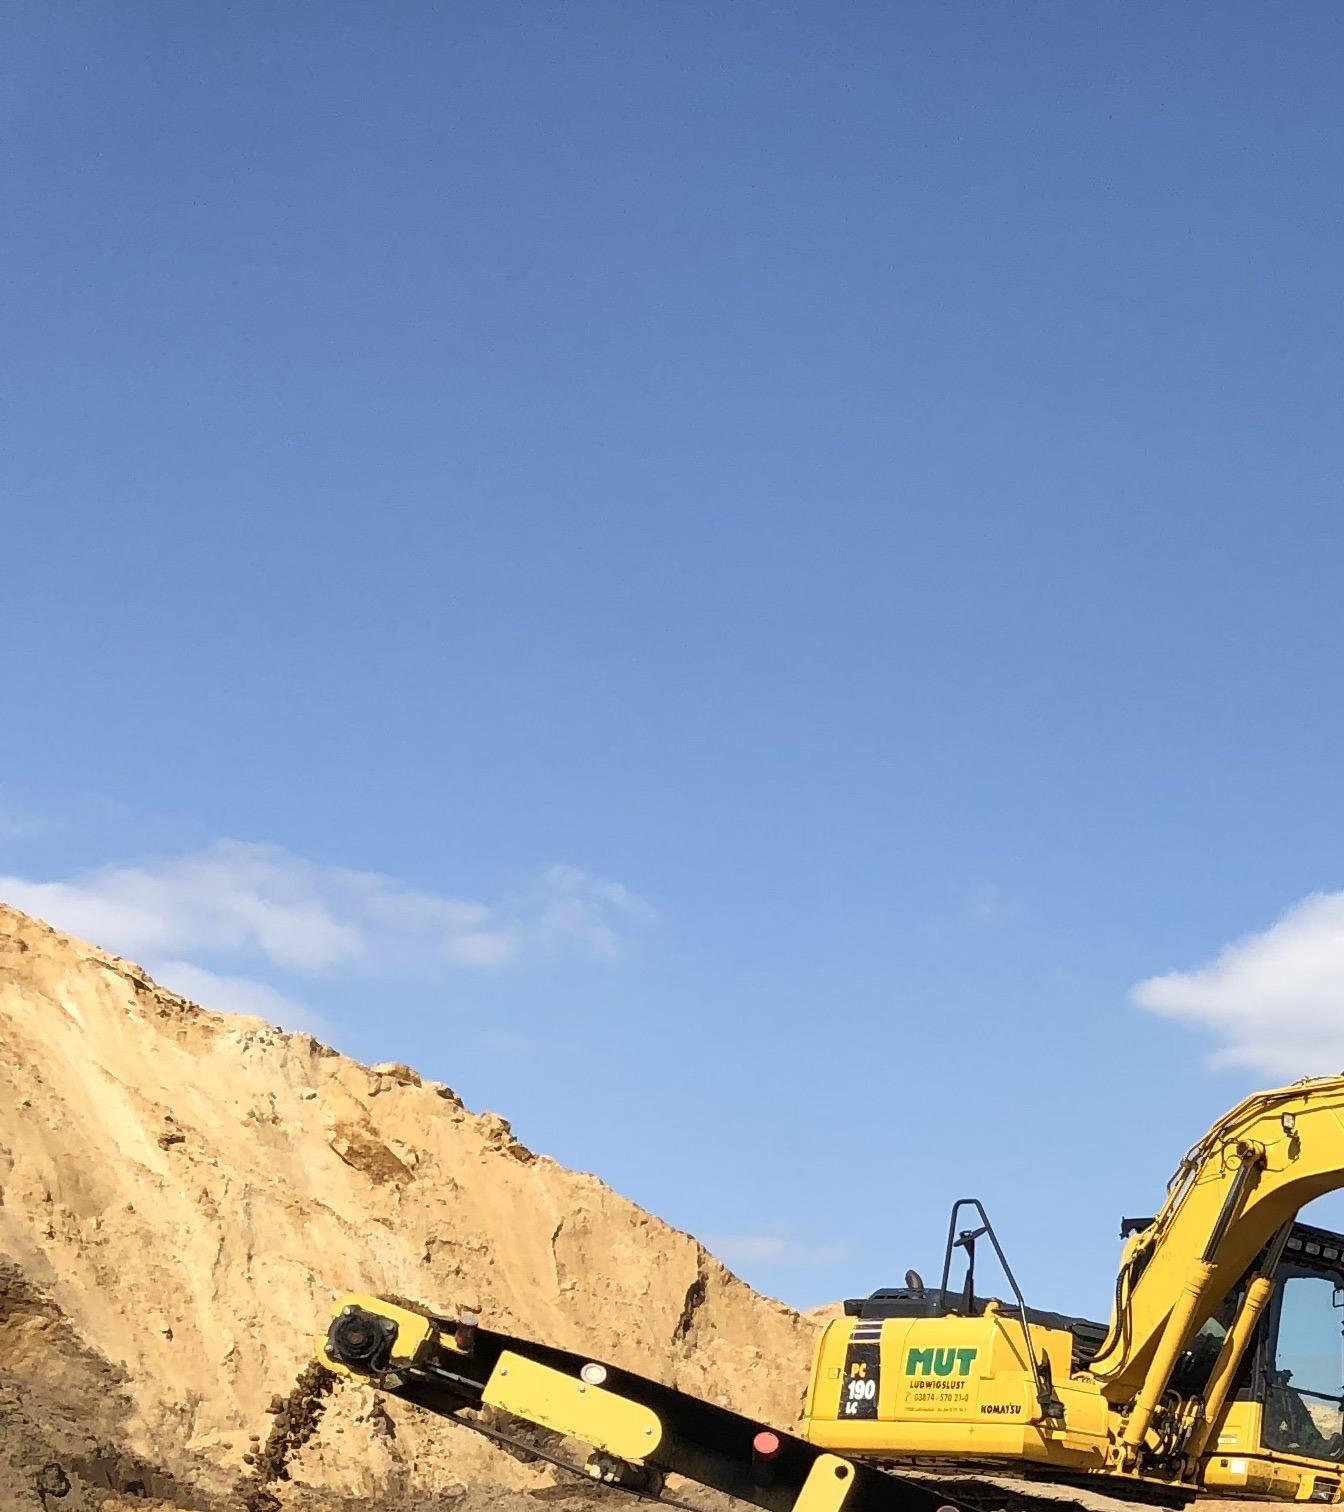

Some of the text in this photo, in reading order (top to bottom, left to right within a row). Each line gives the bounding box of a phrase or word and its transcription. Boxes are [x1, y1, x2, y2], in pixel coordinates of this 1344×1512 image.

[905, 1348, 977, 1376] MUT
[850, 1363, 867, 1379] PC
[848, 1380, 876, 1400] 190
[909, 1380, 965, 1390] LUDWIGSLUST
[914, 1392, 935, 1402] 03874
[845, 1401, 858, 1415] LC
[981, 1403, 1021, 1415] KOMATSU
